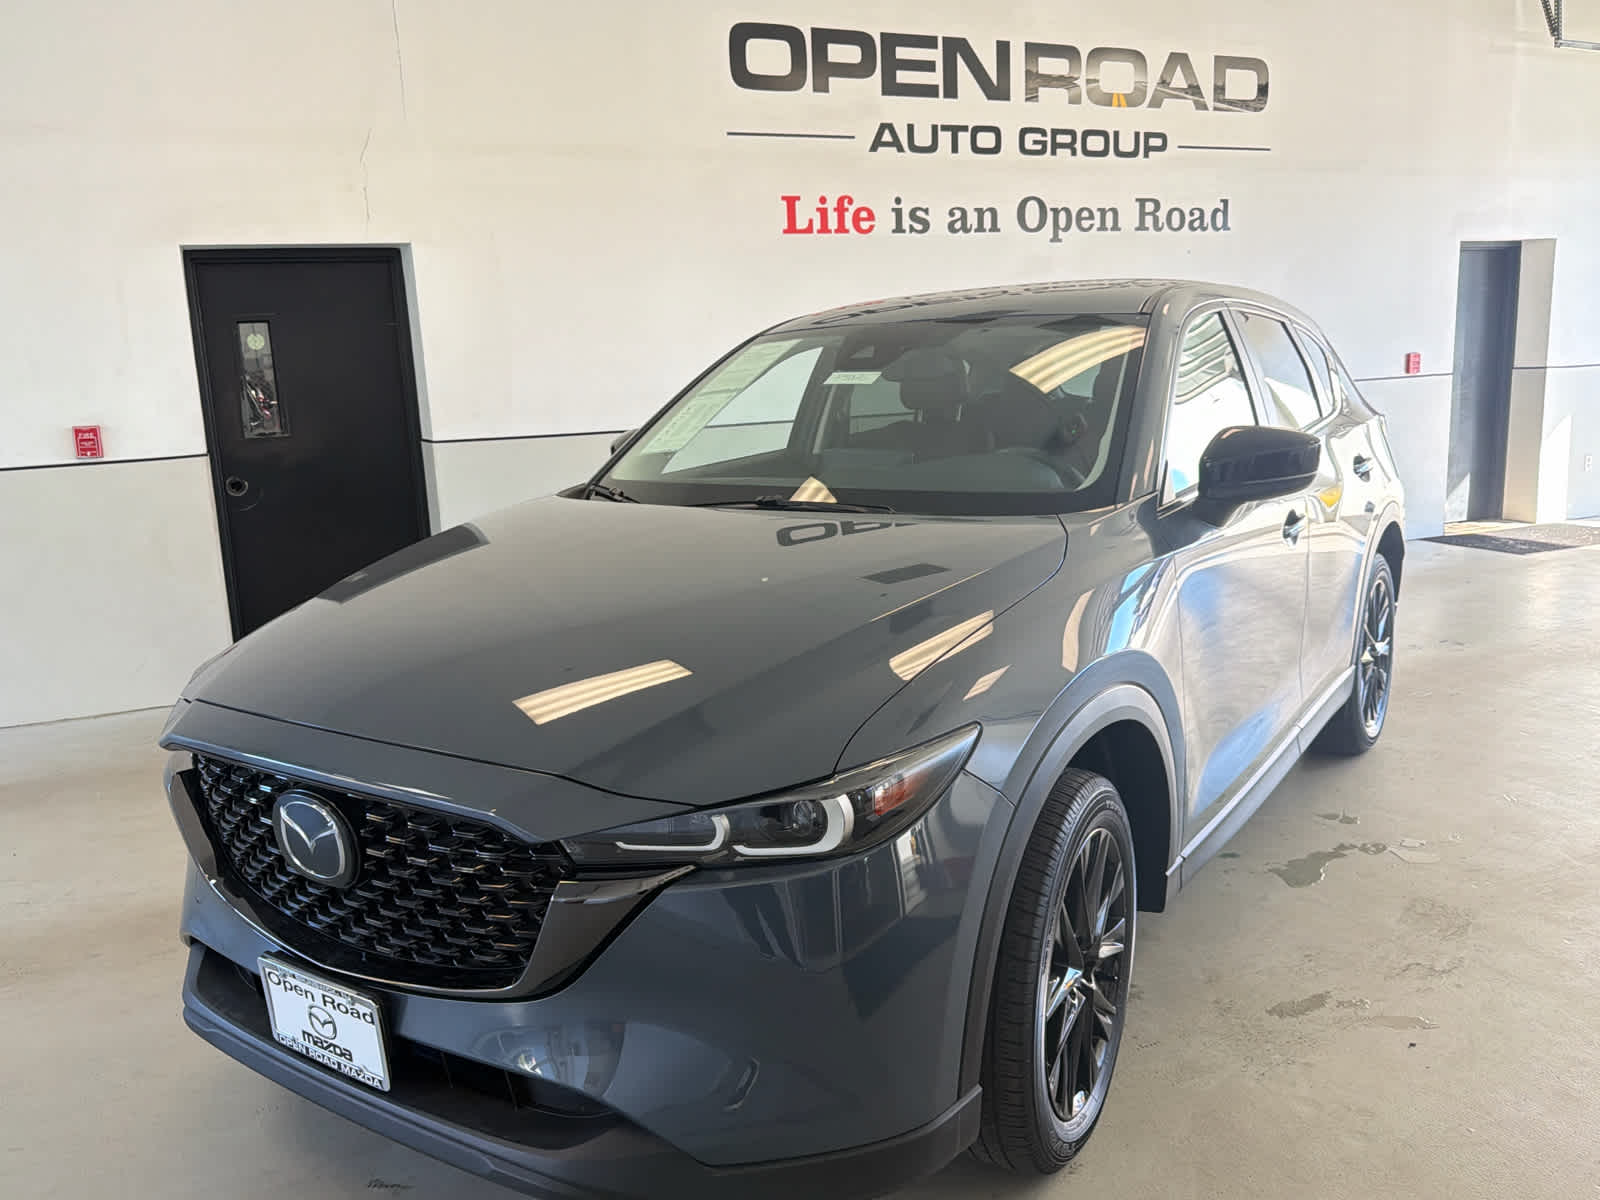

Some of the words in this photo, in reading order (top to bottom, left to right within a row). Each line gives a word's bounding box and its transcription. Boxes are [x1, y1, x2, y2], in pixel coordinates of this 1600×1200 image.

[729, 22, 1010, 102] OPEN
[1025, 42, 1270, 112] ROAD
[869, 123, 1001, 155] AUTO
[1019, 127, 1167, 158] GROUP
[781, 195, 875, 234] Life
[892, 197, 930, 233] is
[948, 207, 1000, 233] an
[1017, 196, 1121, 242] Open
[1135, 198, 1230, 232] Road
[268, 971, 315, 1002] Open
[321, 994, 374, 1024] Road
[309, 1048, 339, 1070] ROAD
[340, 1063, 382, 1089] MAZDA
